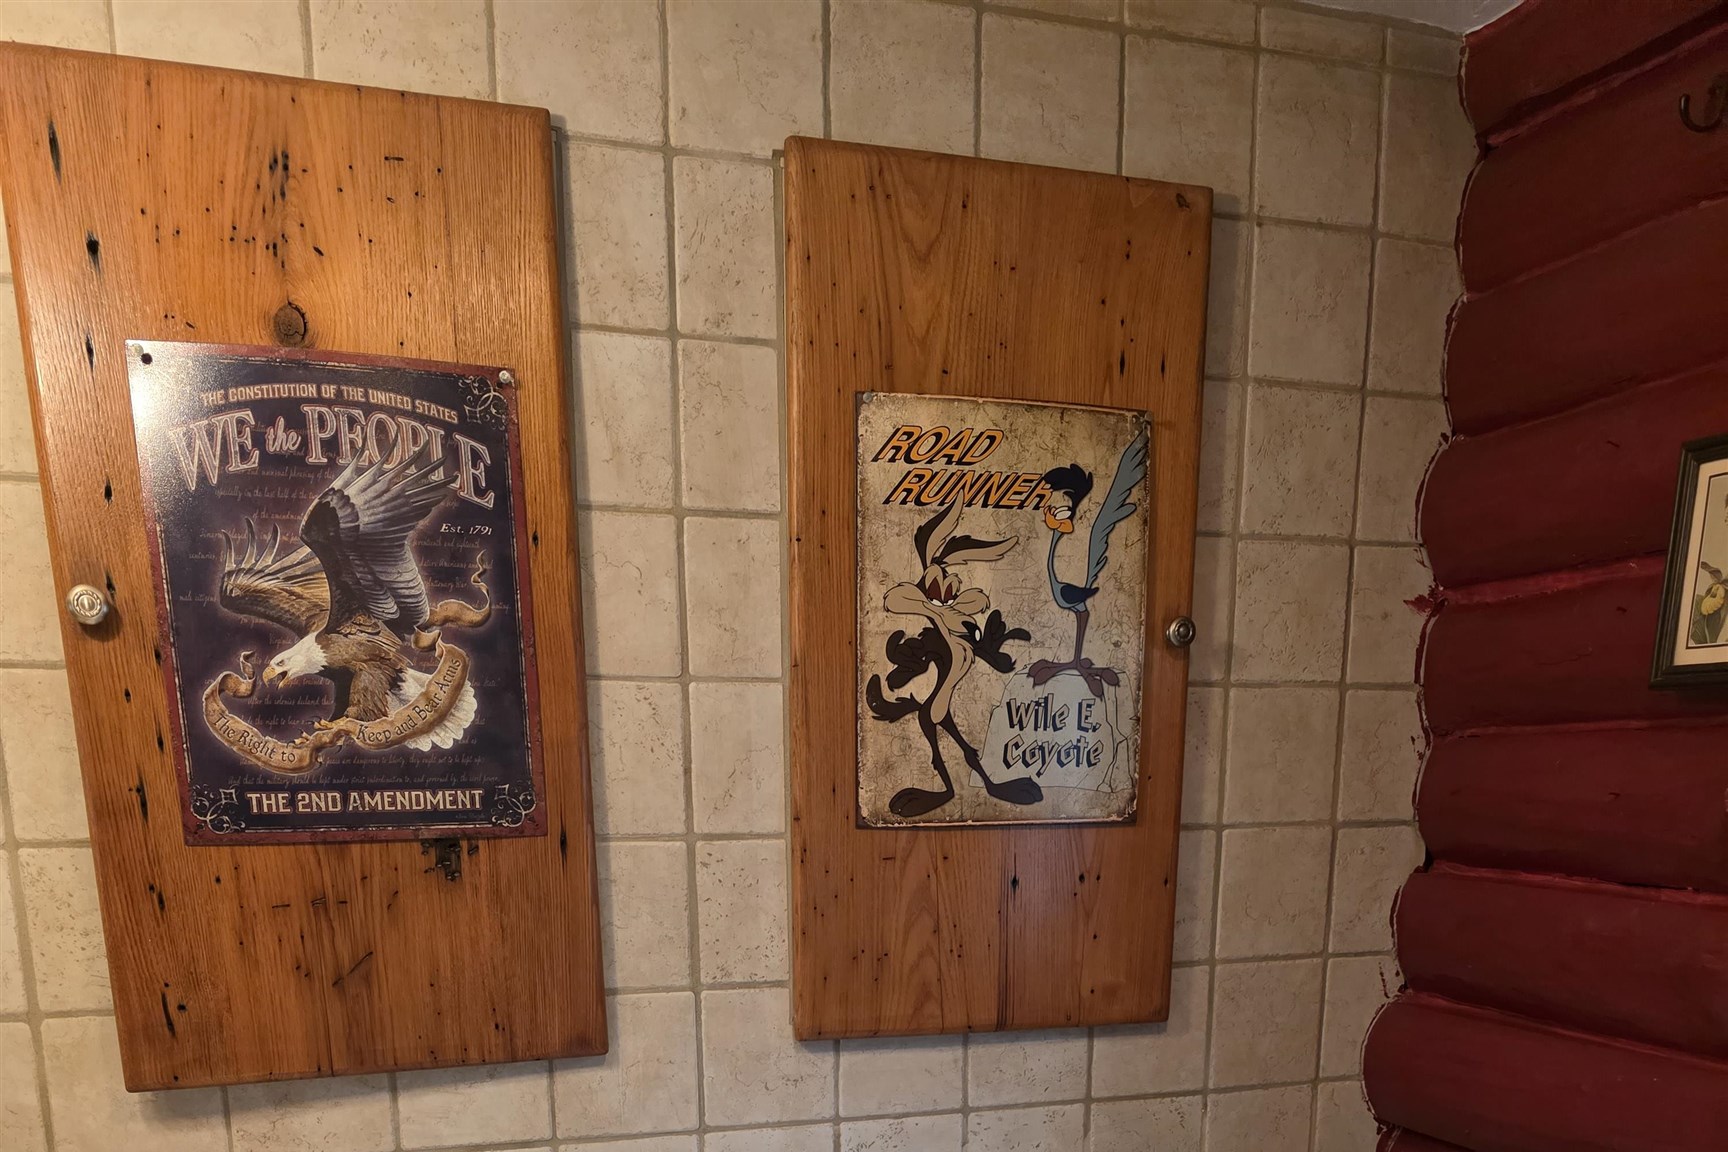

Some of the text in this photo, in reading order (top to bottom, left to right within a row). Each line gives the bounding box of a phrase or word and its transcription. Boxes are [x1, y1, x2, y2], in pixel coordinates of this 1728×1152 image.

[202, 383, 459, 425] THE CONSTITUTION OF THE UNITED STATES
[168, 409, 261, 492] WE
[264, 415, 302, 455] the
[302, 404, 496, 512] PEOPLE
[871, 425, 1004, 465] ROAD
[882, 467, 1053, 510] RUNNER
[440, 523, 493, 536] Est. 1791
[213, 713, 236, 739] The
[237, 729, 276, 761] Right
[281, 750, 296, 763] to
[356, 722, 391, 744] Keep
[394, 714, 418, 736] and
[412, 693, 444, 722] Bear
[434, 658, 462, 695] Arms
[1006, 693, 1102, 733] Wile E.
[1002, 734, 1104, 777] Coyote
[247, 789, 484, 813] THE 2ND AMENDMENT
